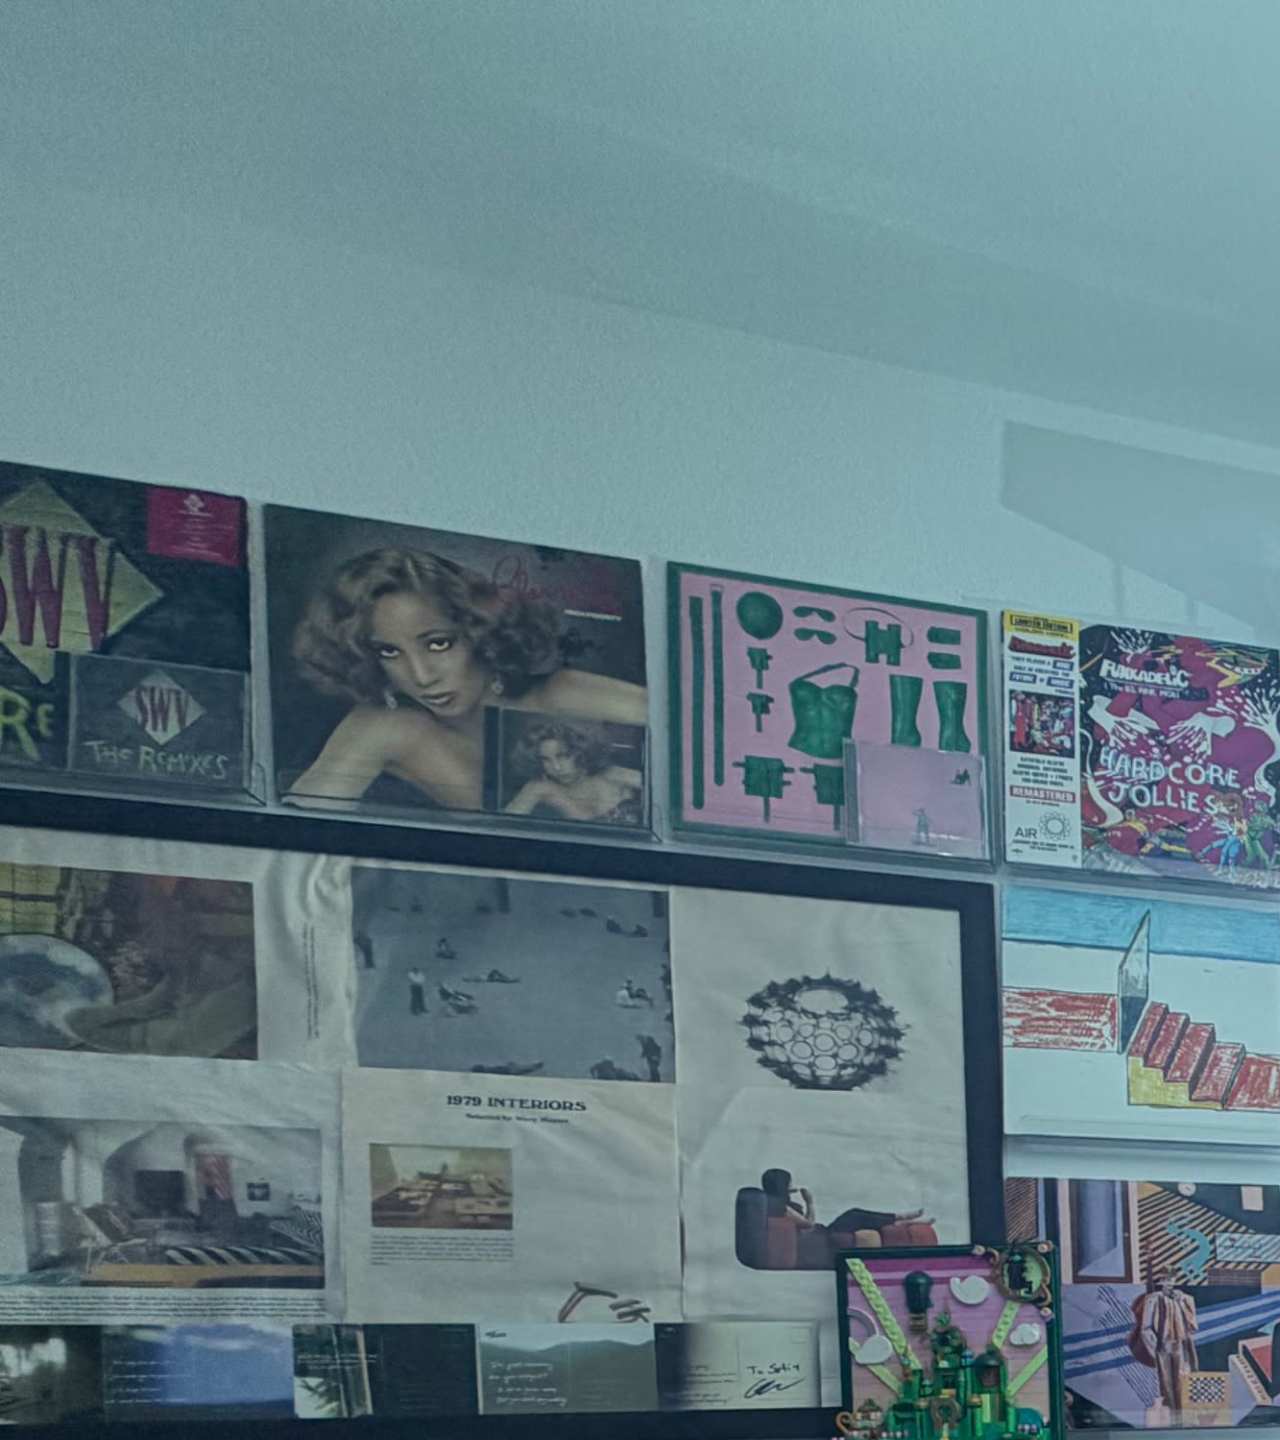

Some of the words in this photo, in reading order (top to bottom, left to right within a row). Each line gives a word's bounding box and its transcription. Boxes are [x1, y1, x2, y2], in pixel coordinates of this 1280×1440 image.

[0, 525, 115, 648] WV
[1100, 751, 1242, 789] HARDCORE
[1012, 787, 1074, 802] REMASTERED
[1108, 783, 1225, 816] JOLLIES
[1015, 826, 1037, 839] AIR
[447, 1095, 482, 1107] 1979
[487, 1096, 587, 1112] INTERIORS
